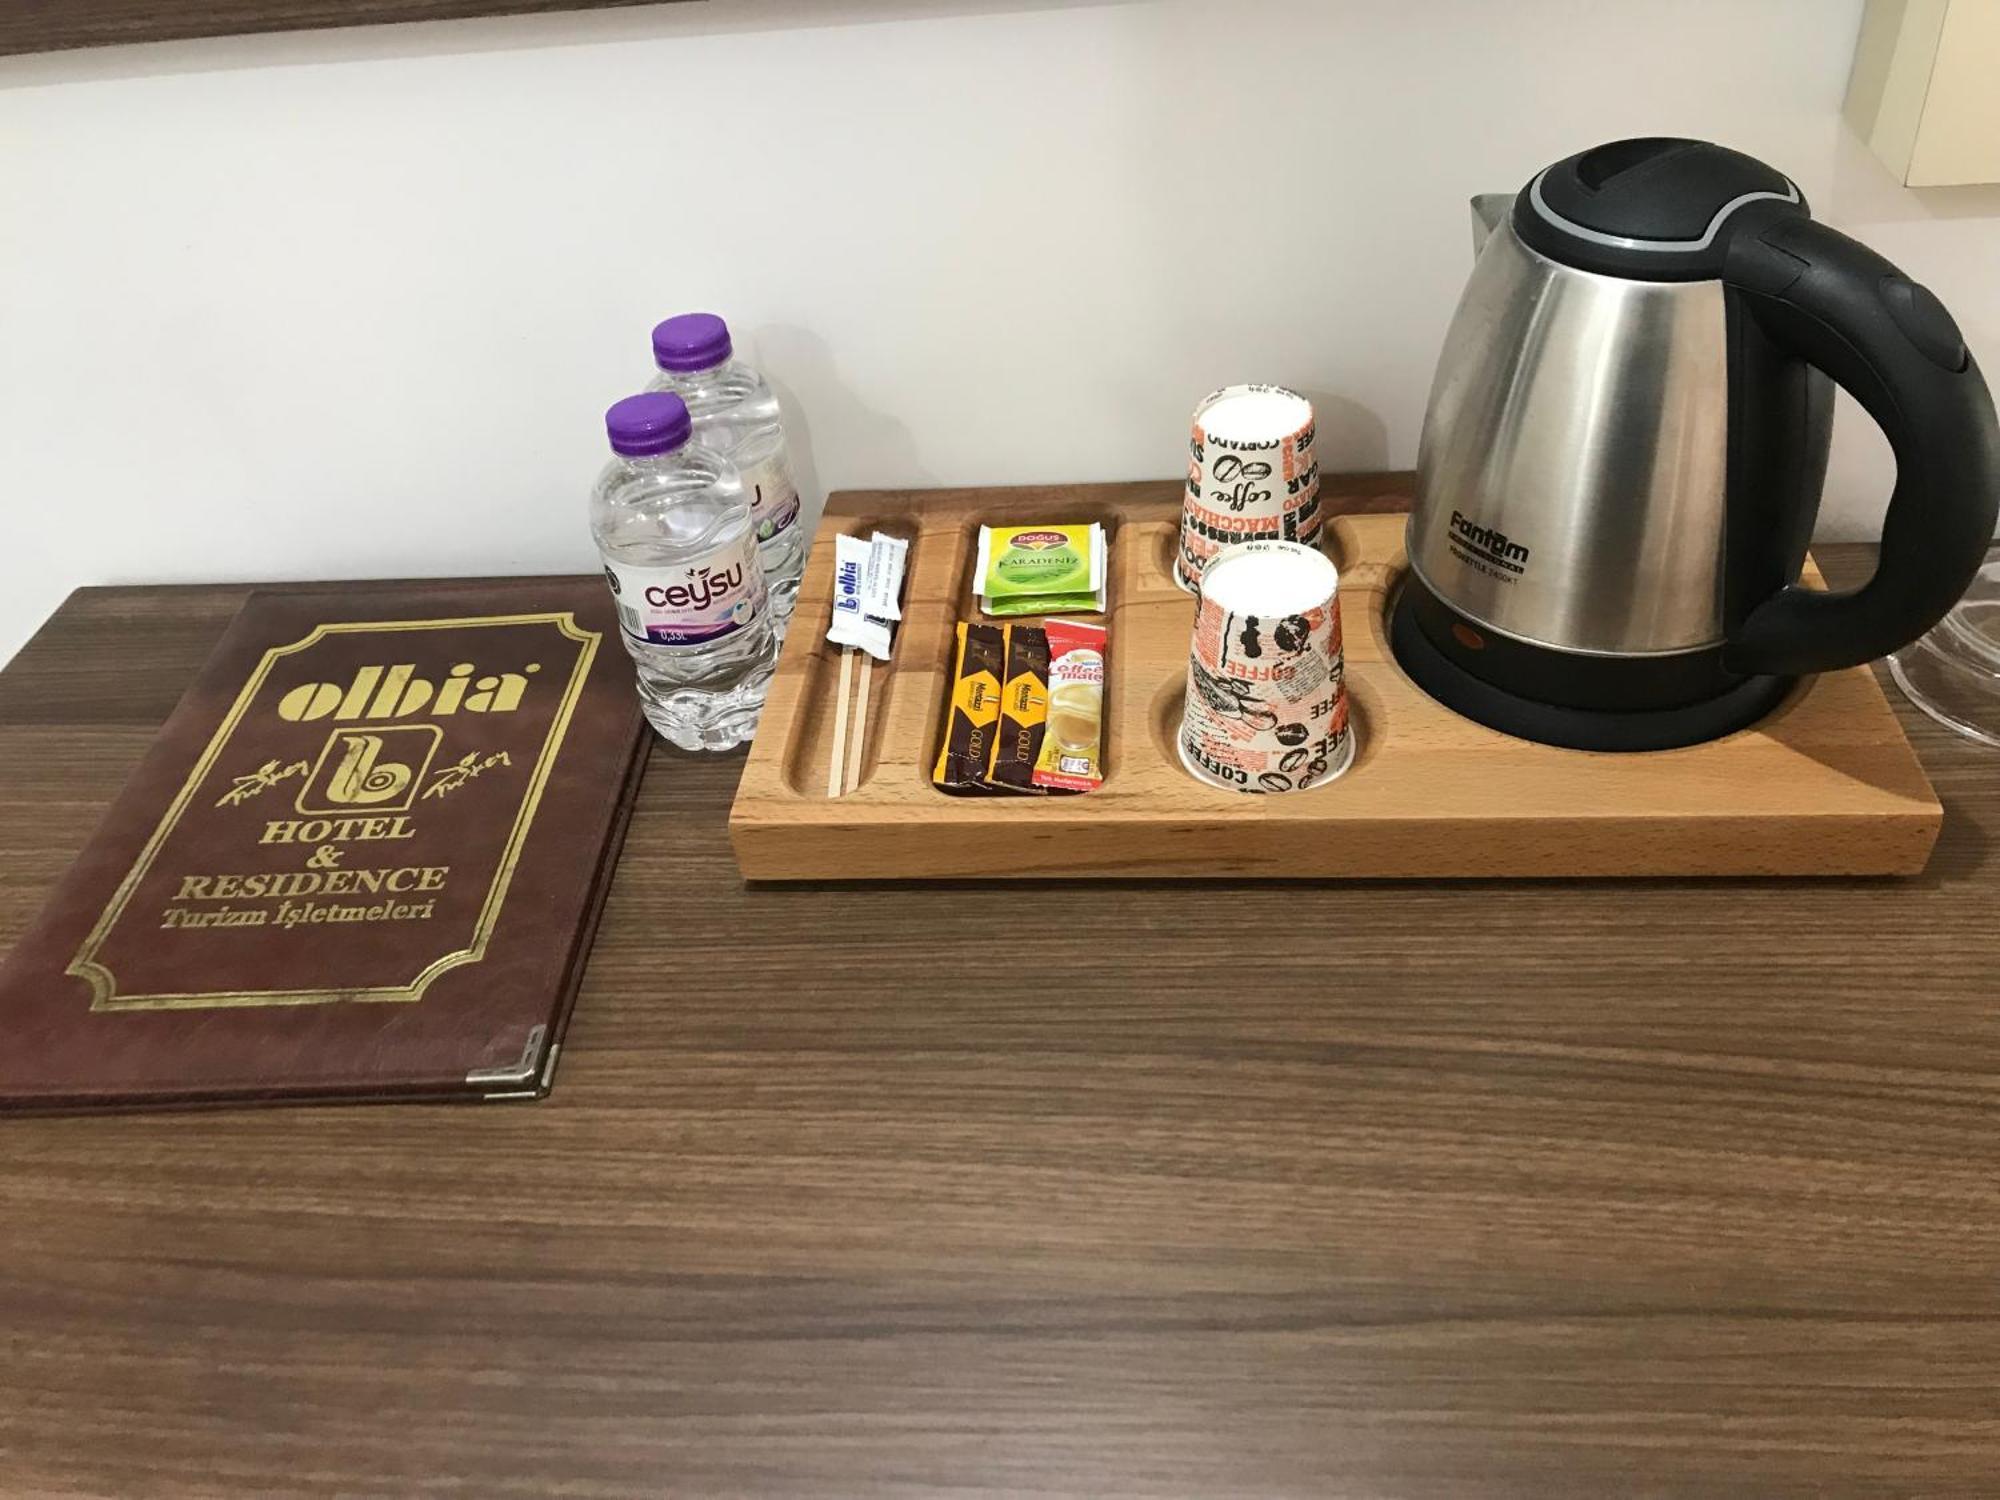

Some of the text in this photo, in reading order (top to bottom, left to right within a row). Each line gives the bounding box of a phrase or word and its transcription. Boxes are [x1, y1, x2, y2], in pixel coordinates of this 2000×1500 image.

[1210, 481, 1272, 512] coffee
[644, 562, 743, 611] ceysu
[838, 562, 857, 595] olbia
[1229, 659, 1297, 682] COFFEE
[278, 663, 529, 721] olbia
[968, 728, 984, 759] GOLD
[1016, 729, 1032, 762] GOLD
[258, 815, 417, 844] HOTEL
[306, 844, 346, 869] &
[172, 866, 450, 902] RESIDENCE
[160, 898, 434, 930] Turizm İşletmeleri
